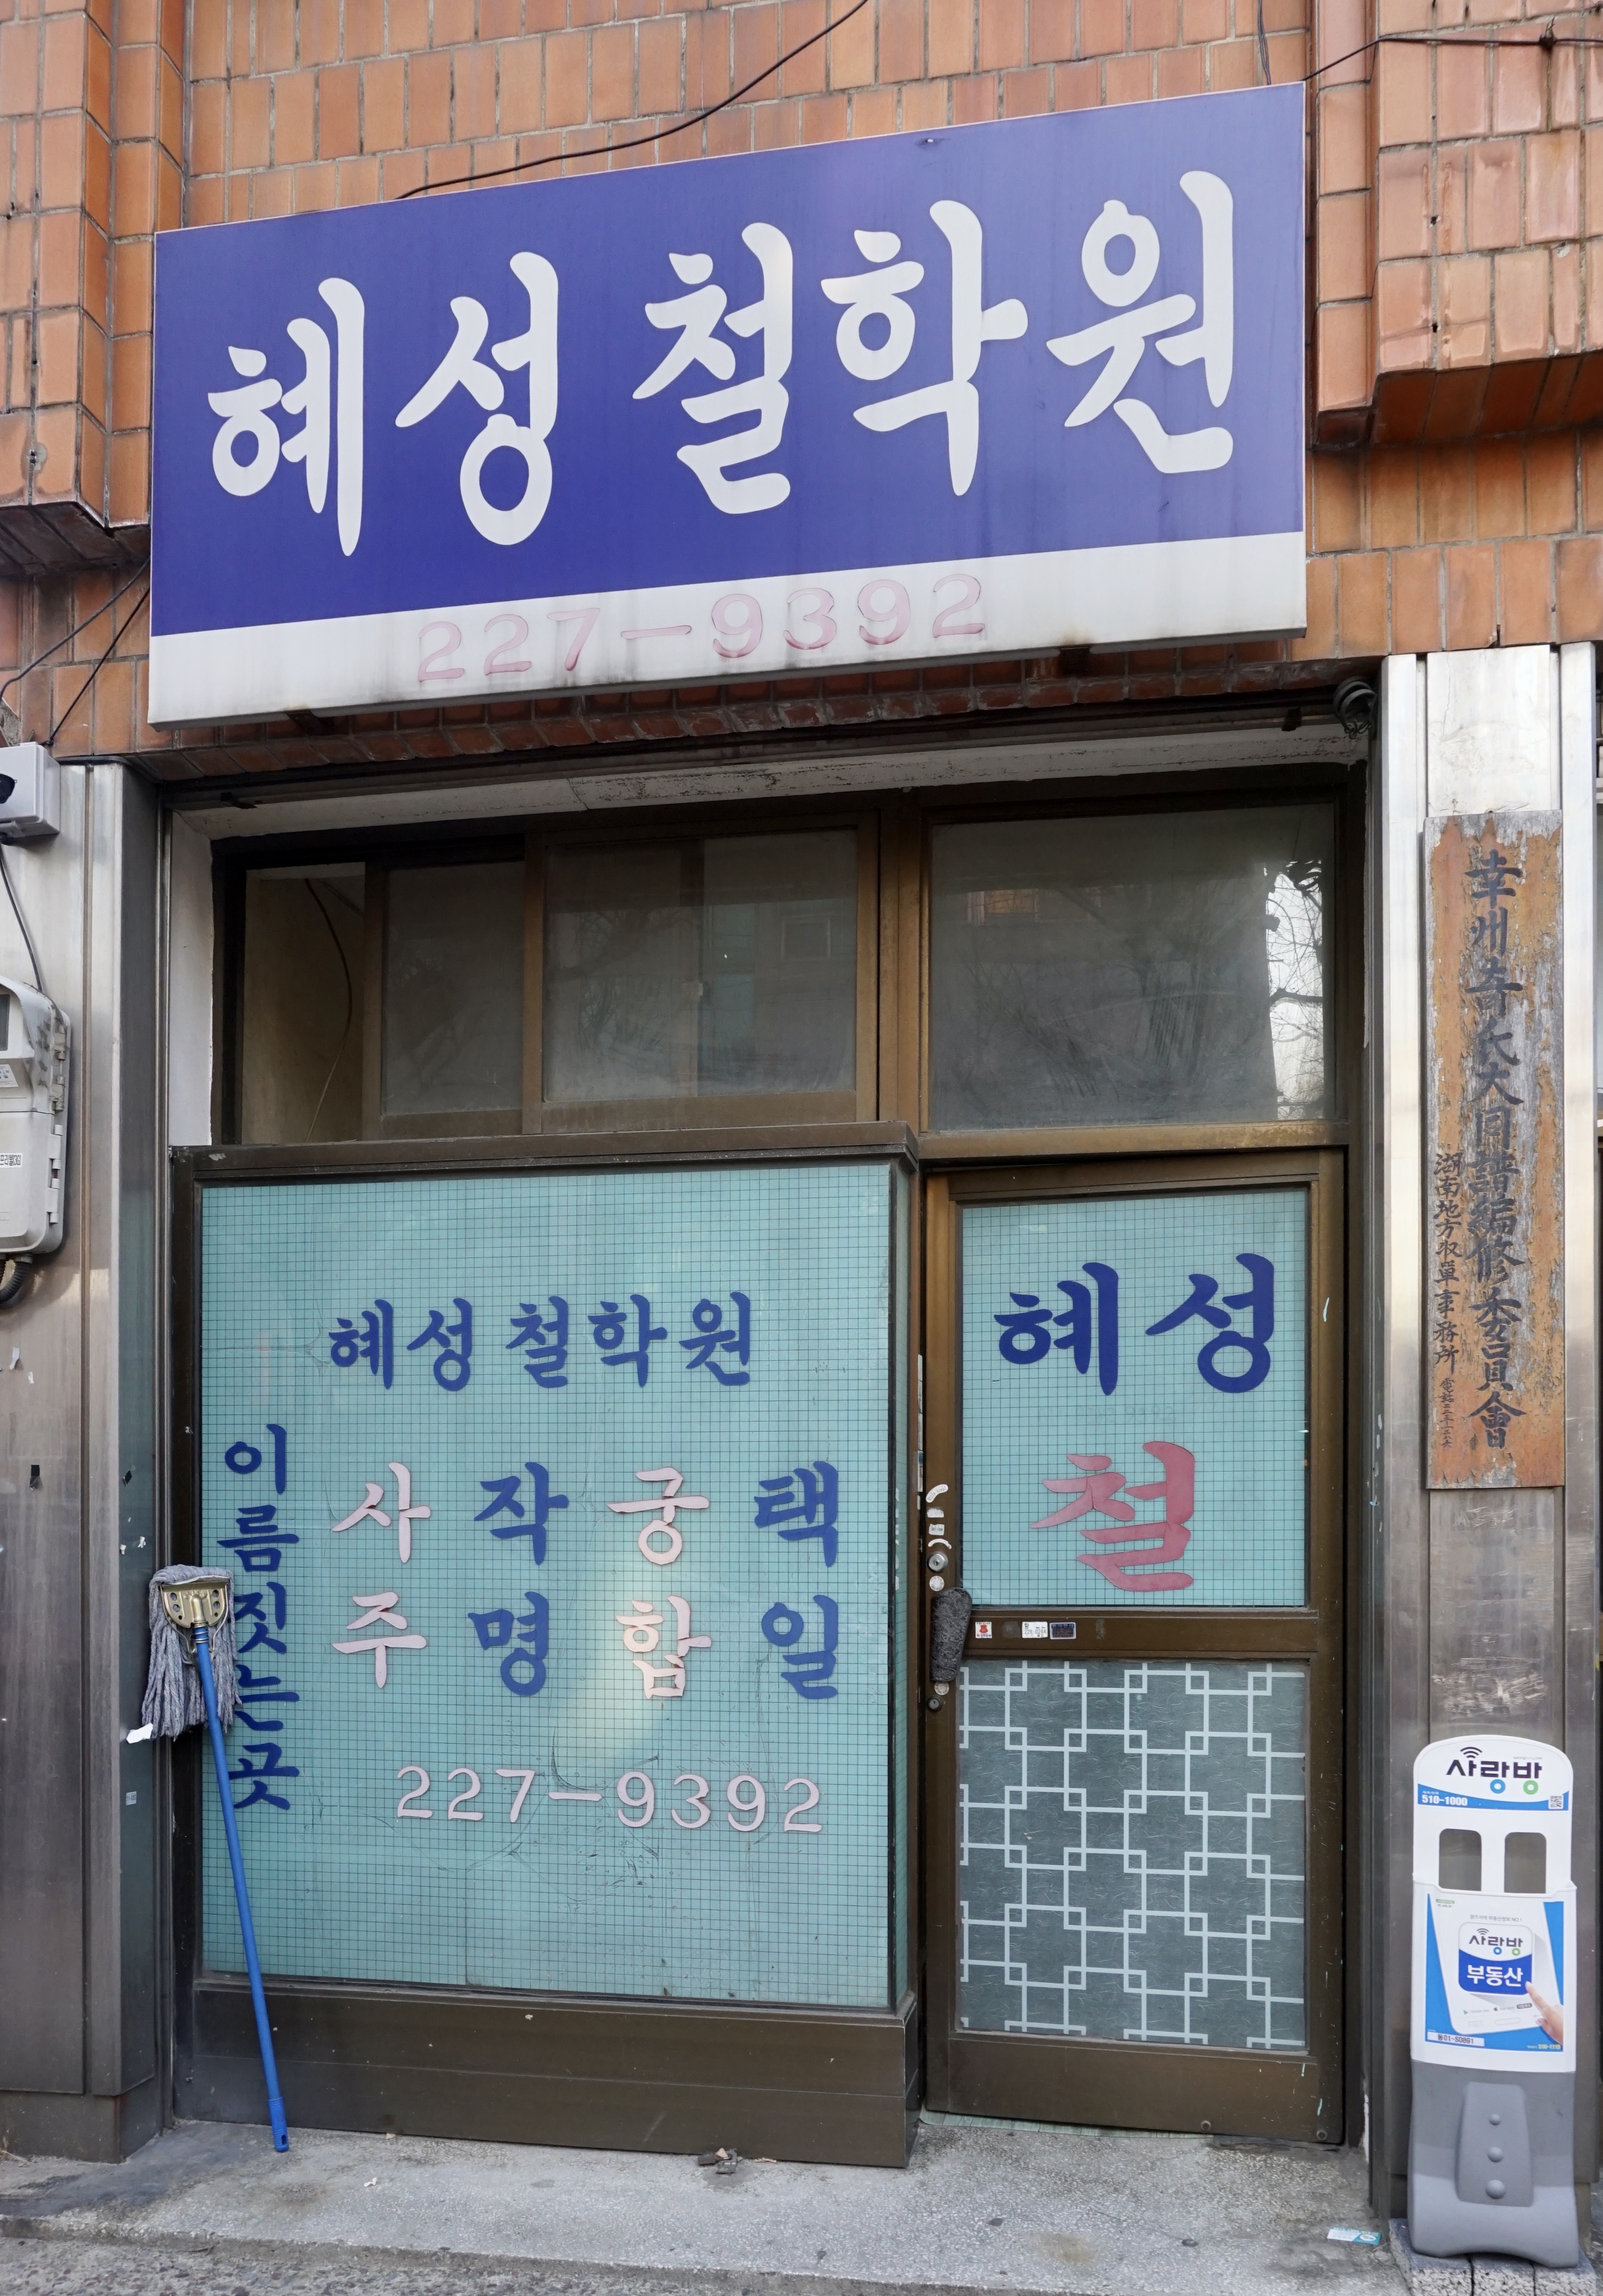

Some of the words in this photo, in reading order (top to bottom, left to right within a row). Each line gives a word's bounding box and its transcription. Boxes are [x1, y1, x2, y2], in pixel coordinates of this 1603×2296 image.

[207, 251, 559, 556] 혜성
[633, 171, 1234, 514] 철학원
[417, 573, 987, 683] 227-9392
[329, 1298, 473, 1391] 혜성
[506, 1292, 751, 1388] 철학원
[994, 1253, 1274, 1395] 혜성
[1030, 1441, 1195, 1592] 철
[331, 1461, 431, 1689] 사주
[468, 1462, 569, 1696] 작명
[754, 1461, 839, 1699] 택일
[397, 1765, 822, 1833] 227-9392
[1422, 1794, 1468, 1806] 510-1000
[1446, 1759, 1542, 1795] 사랑방
[1466, 1964, 1524, 1988] 부동산
[1469, 1935, 1523, 1957] 사랑방
